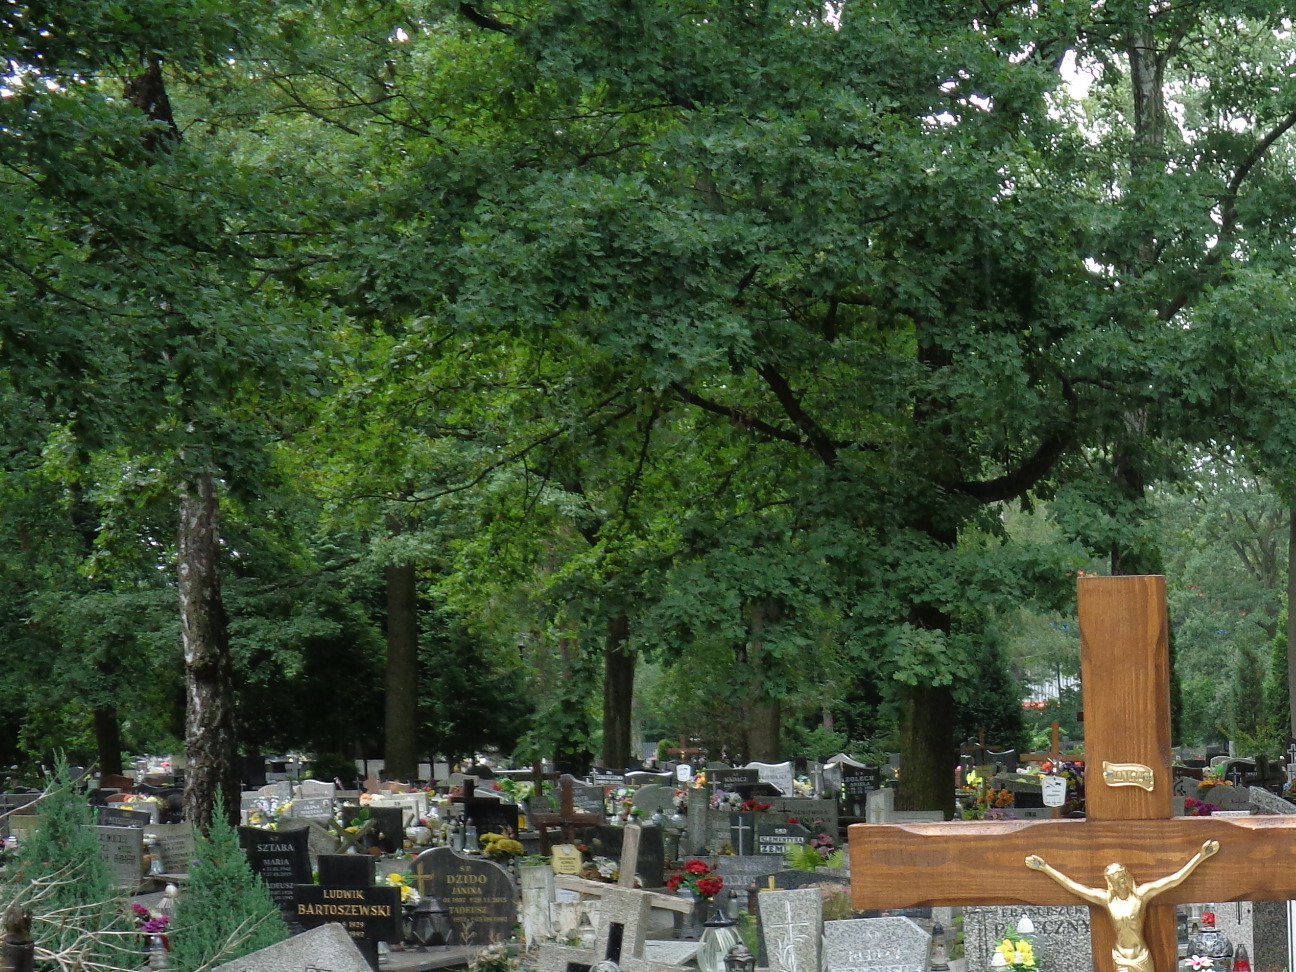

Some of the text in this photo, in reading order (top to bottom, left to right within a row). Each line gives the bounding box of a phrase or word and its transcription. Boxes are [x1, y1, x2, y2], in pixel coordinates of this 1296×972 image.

[256, 843, 295, 852] SZTABA
[446, 874, 487, 884] DZIDO
[323, 889, 365, 900] LUDWIK
[297, 903, 391, 917] BARTOSZEWSKI
